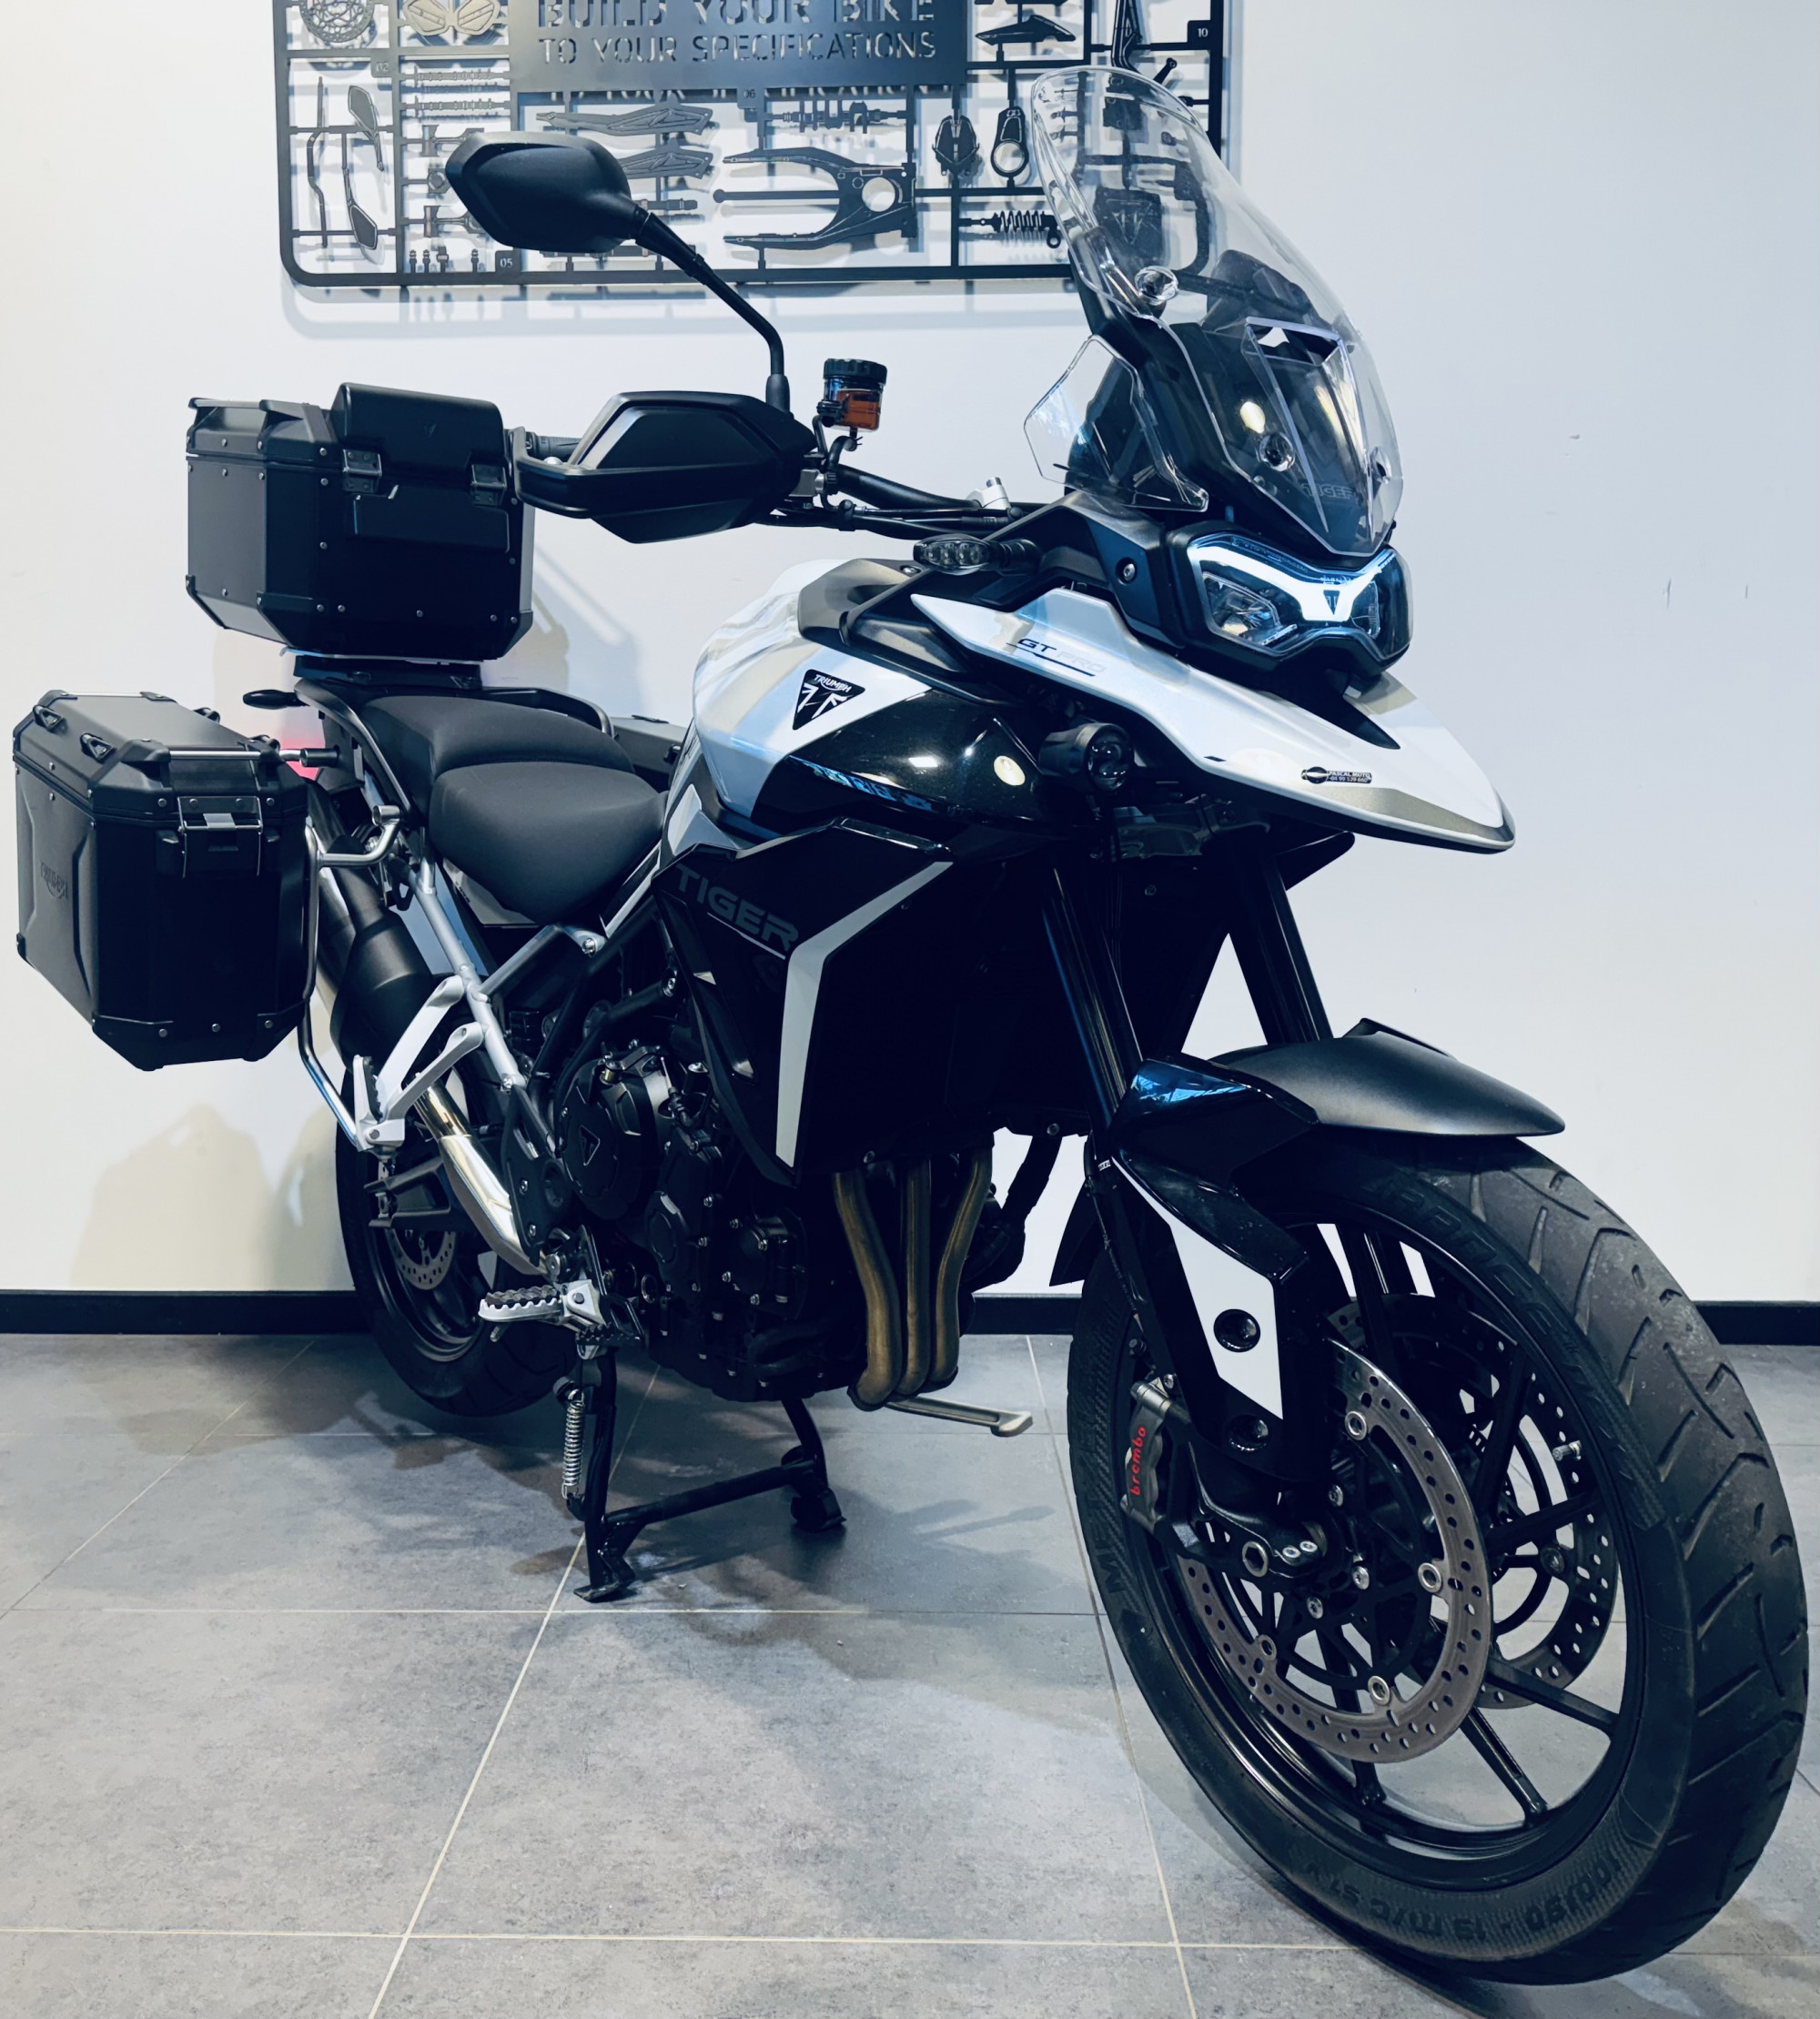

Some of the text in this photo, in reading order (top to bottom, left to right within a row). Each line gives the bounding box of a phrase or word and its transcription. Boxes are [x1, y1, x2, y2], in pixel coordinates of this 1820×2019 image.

[539, 0, 935, 27] BUILD YOUR BIKE
[1198, 27, 1208, 37] 10
[539, 31, 935, 64] TO YOUR SPECIFICATIONS
[500, 257, 513, 268] 05
[1017, 638, 1107, 673] GT PRO
[814, 673, 852, 694] TRIUMPH
[675, 863, 799, 952] TIGER
[1129, 1425, 1146, 1496] brembo
